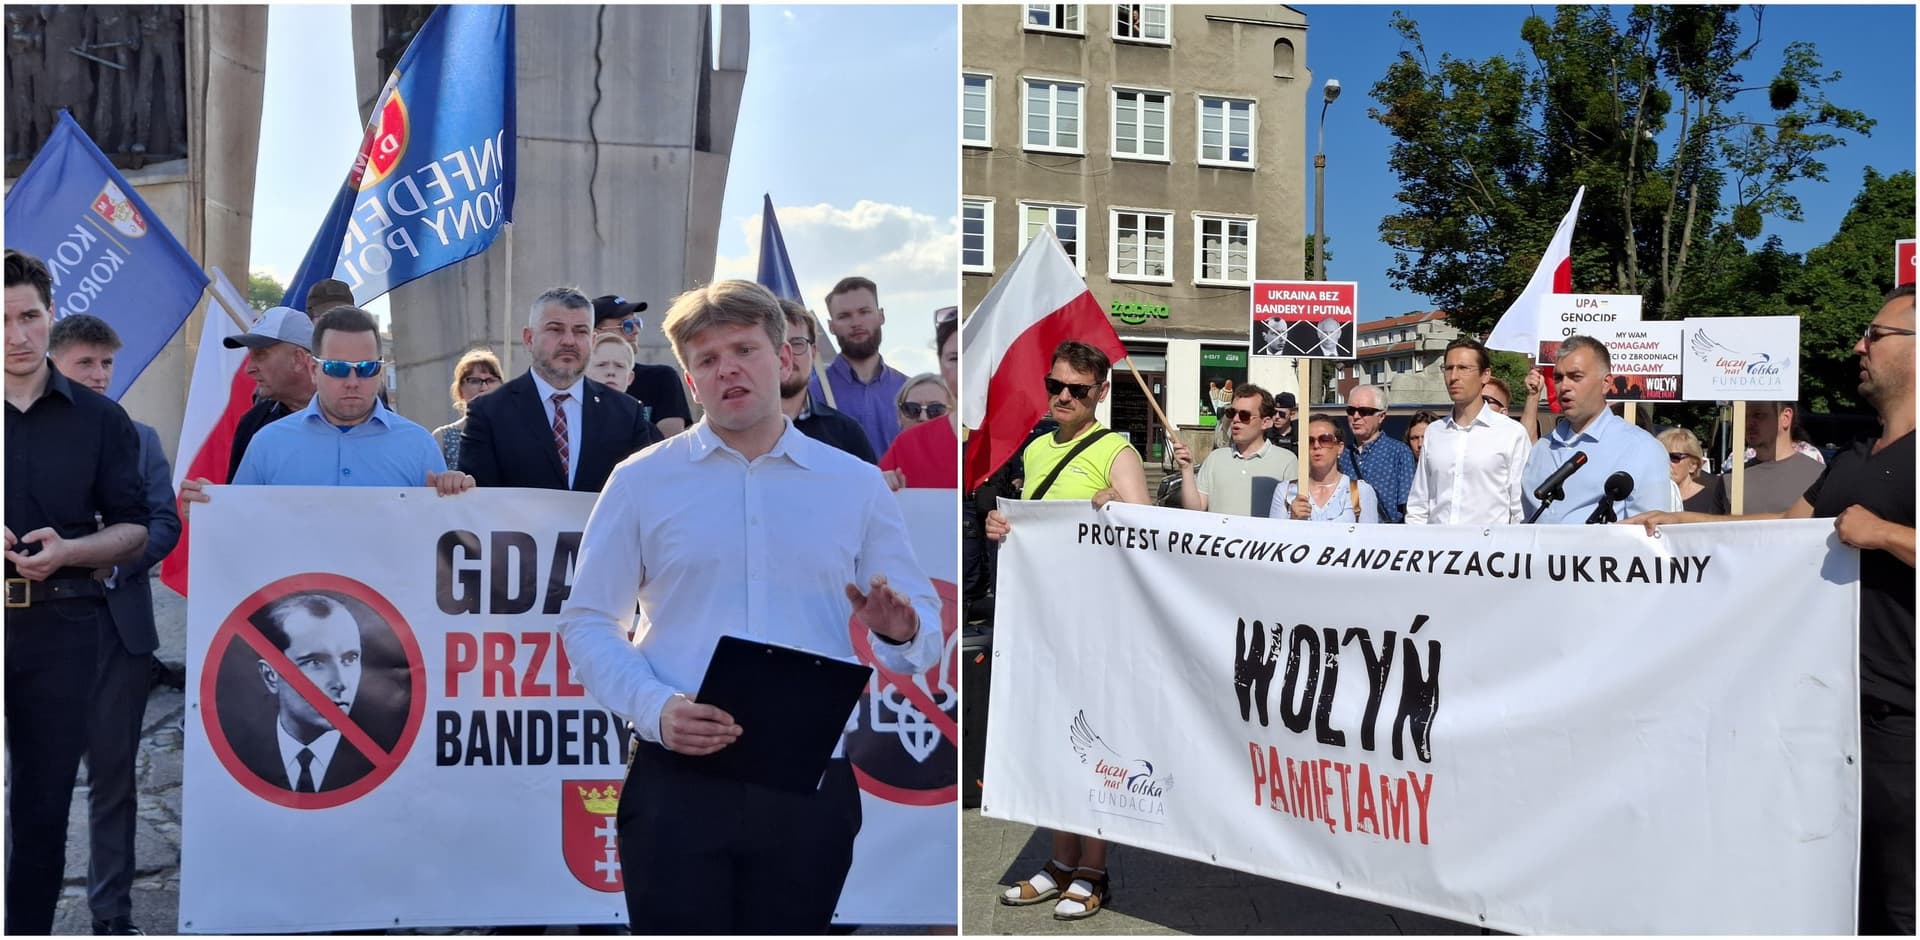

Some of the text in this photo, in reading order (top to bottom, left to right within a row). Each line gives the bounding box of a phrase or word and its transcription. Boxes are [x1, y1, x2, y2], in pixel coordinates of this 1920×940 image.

[1268, 290, 1340, 302] UKRAINA BEZ
[1255, 303, 1352, 315] BANDERY I PUTINA
[1576, 298, 1599, 309] UPA
[1561, 327, 1577, 337] OF
[1615, 331, 1648, 339] MY WAM
[1629, 353, 1679, 361] ZBRODNIACH
[1610, 363, 1664, 373] YMAGAMY
[1712, 376, 1782, 386] FUNDACJA
[1078, 523, 1712, 584] PROTEST PRZECIWKO BANDERYZACJI UKRAINY
[1249, 741, 1434, 845] PAMIĘTAMY
[1088, 788, 1165, 816] FUNDACJA
